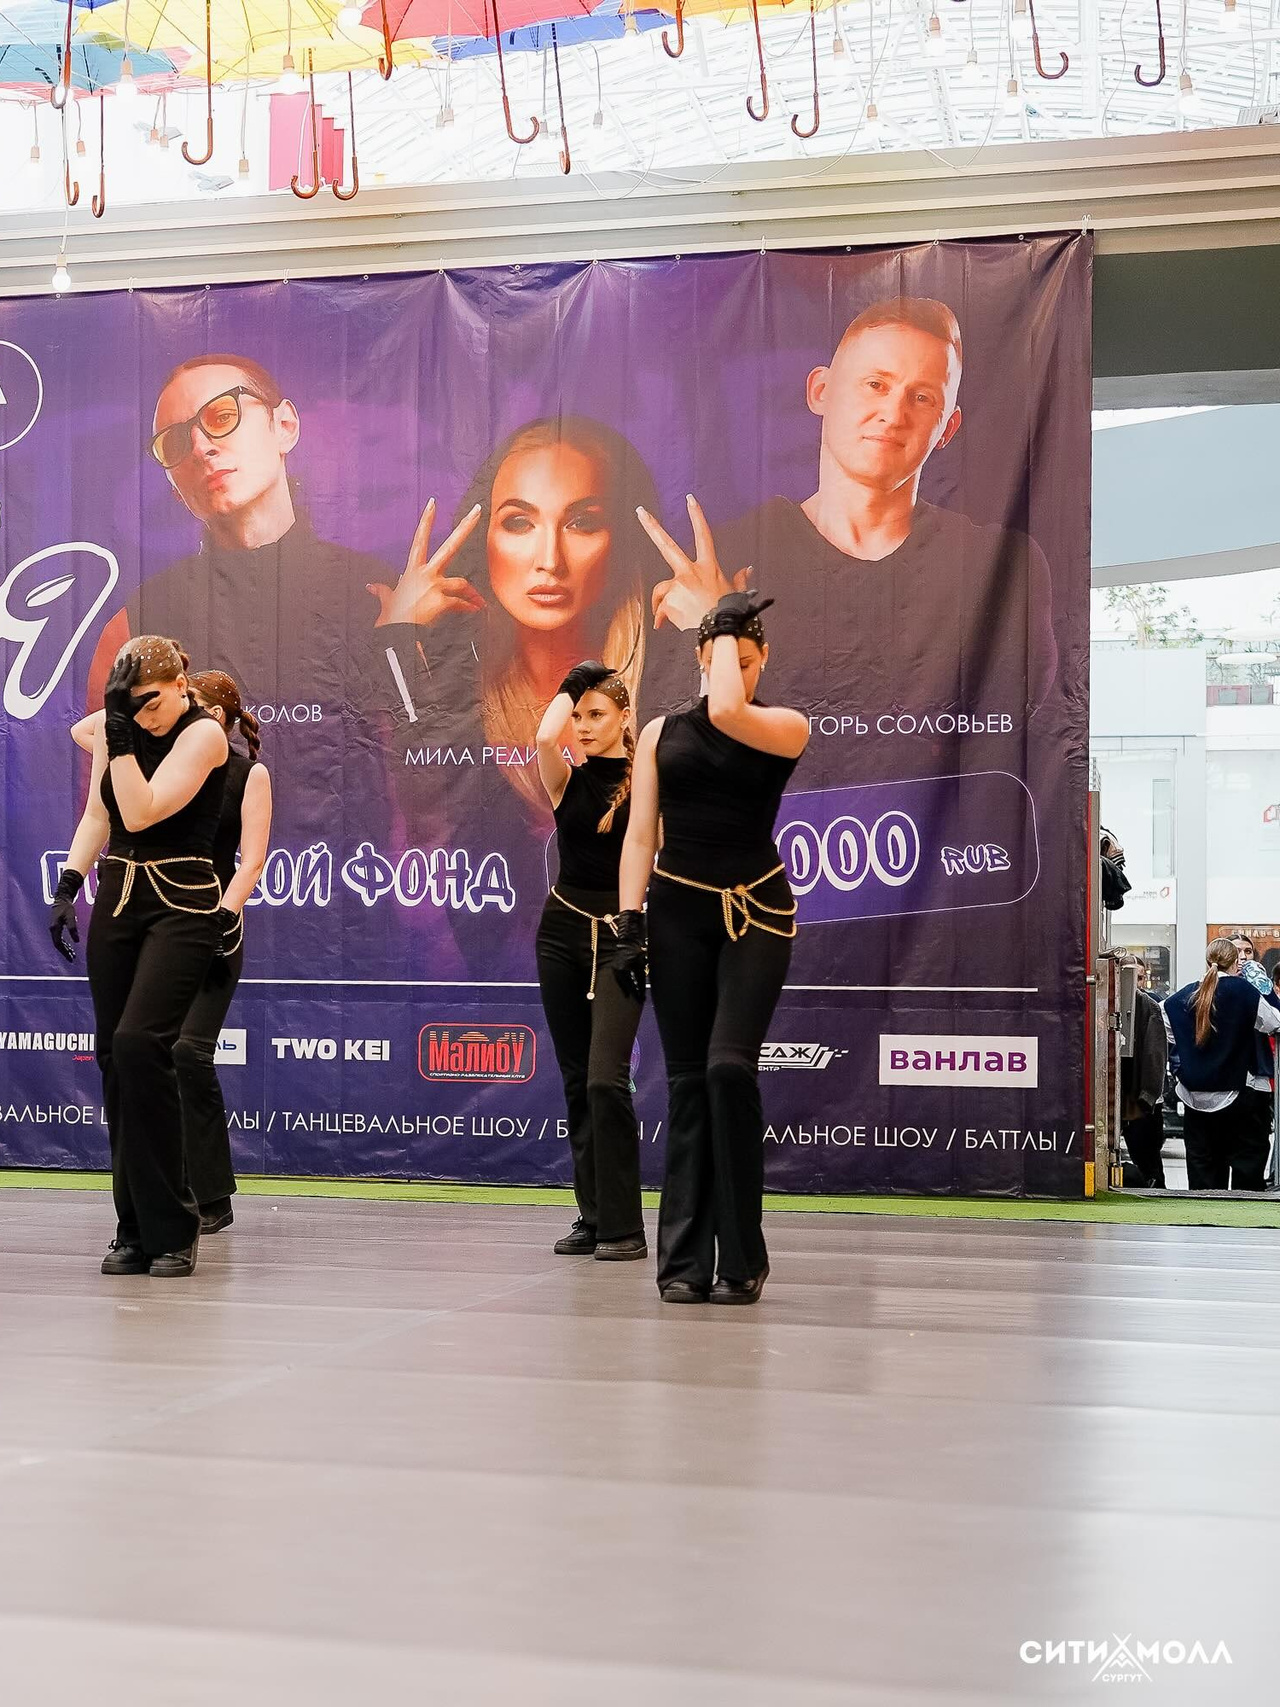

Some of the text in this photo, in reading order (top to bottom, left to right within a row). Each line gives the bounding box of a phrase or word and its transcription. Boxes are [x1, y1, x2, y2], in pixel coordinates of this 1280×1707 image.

[808, 713, 1013, 735] ГОРЬ СОЛОВЬЕВ
[405, 746, 575, 767] МИЛА РЕДИА
[776, 811, 1011, 896] 000 RUB
[341, 842, 516, 913] ФОНД
[271, 1037, 390, 1061] TWO KEI
[760, 1046, 812, 1058] САЖ
[890, 1050, 1027, 1073] ванлав
[281, 1111, 465, 1136] ТАНЦЕВАЛЬНОЕ
[472, 1116, 531, 1138] ШОУ
[762, 1124, 866, 1146] АЛЬНОЕ
[874, 1126, 938, 1148] ШОУ
[965, 1129, 1057, 1151] БАТТЛЫ
